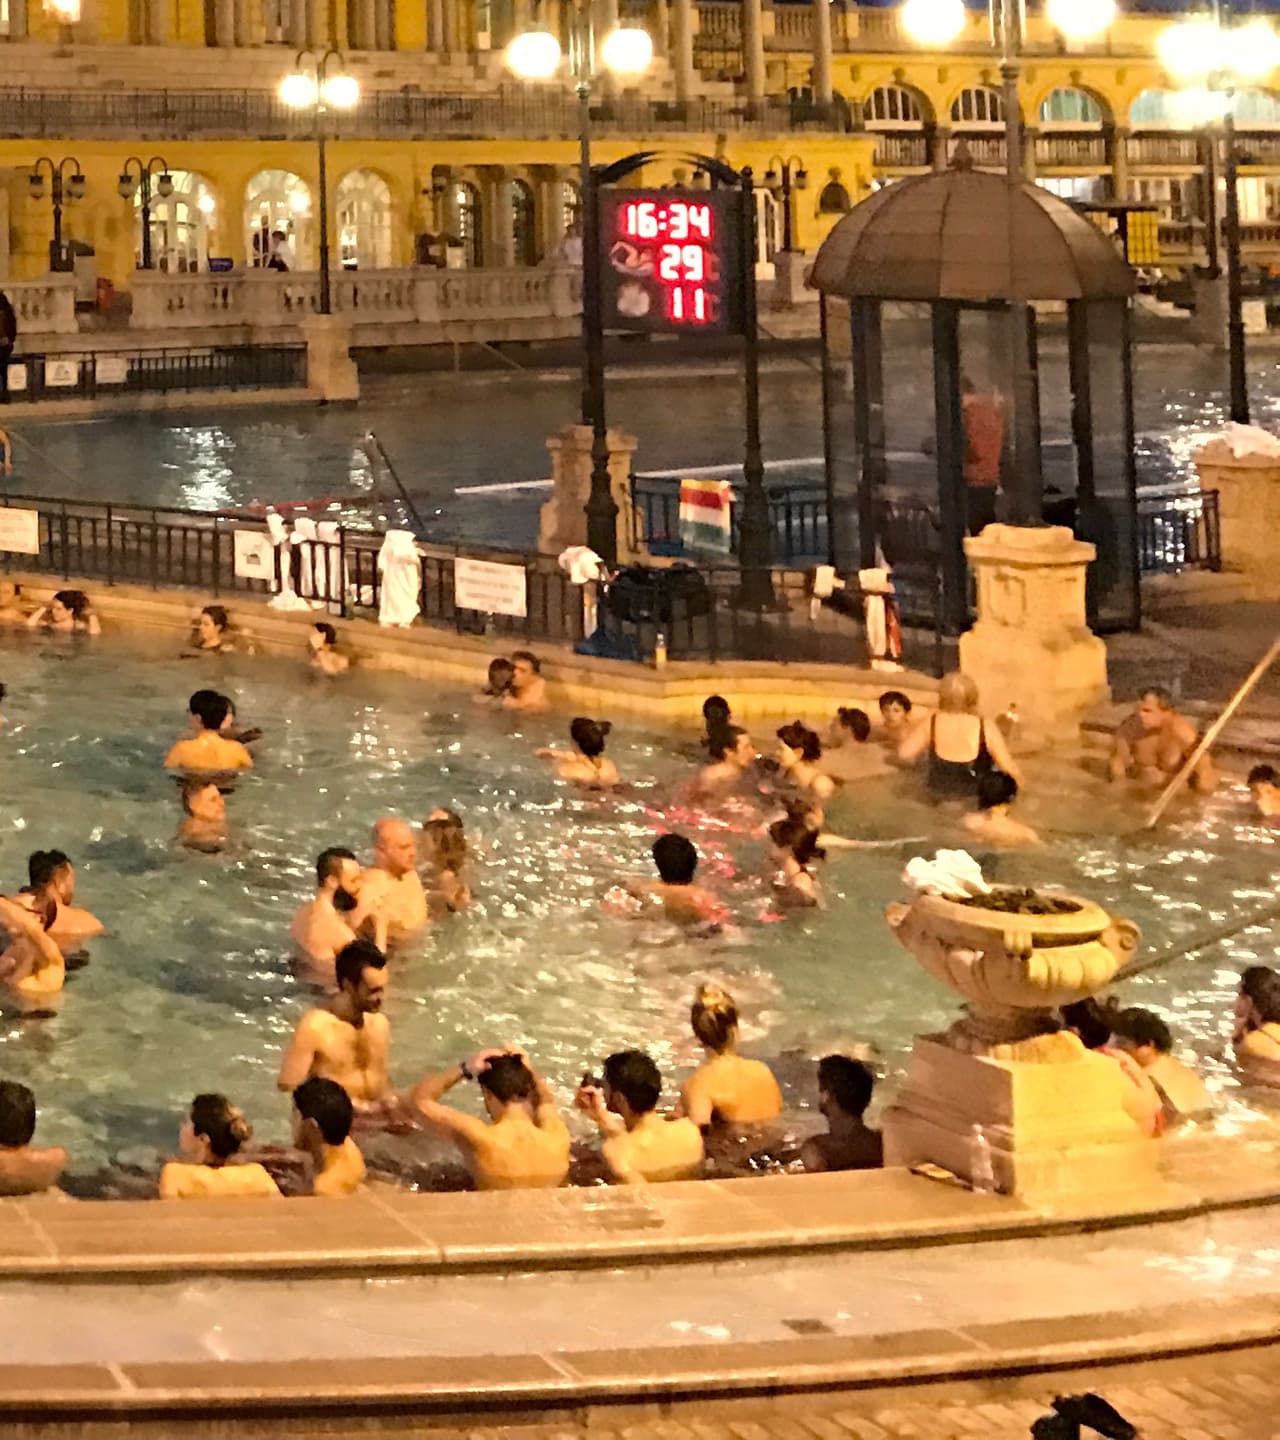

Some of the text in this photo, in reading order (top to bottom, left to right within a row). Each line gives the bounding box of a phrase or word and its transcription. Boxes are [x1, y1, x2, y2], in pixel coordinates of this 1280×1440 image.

[626, 202, 710, 240] 16:34
[659, 244, 704, 281] 29
[672, 287, 705, 320] 11
